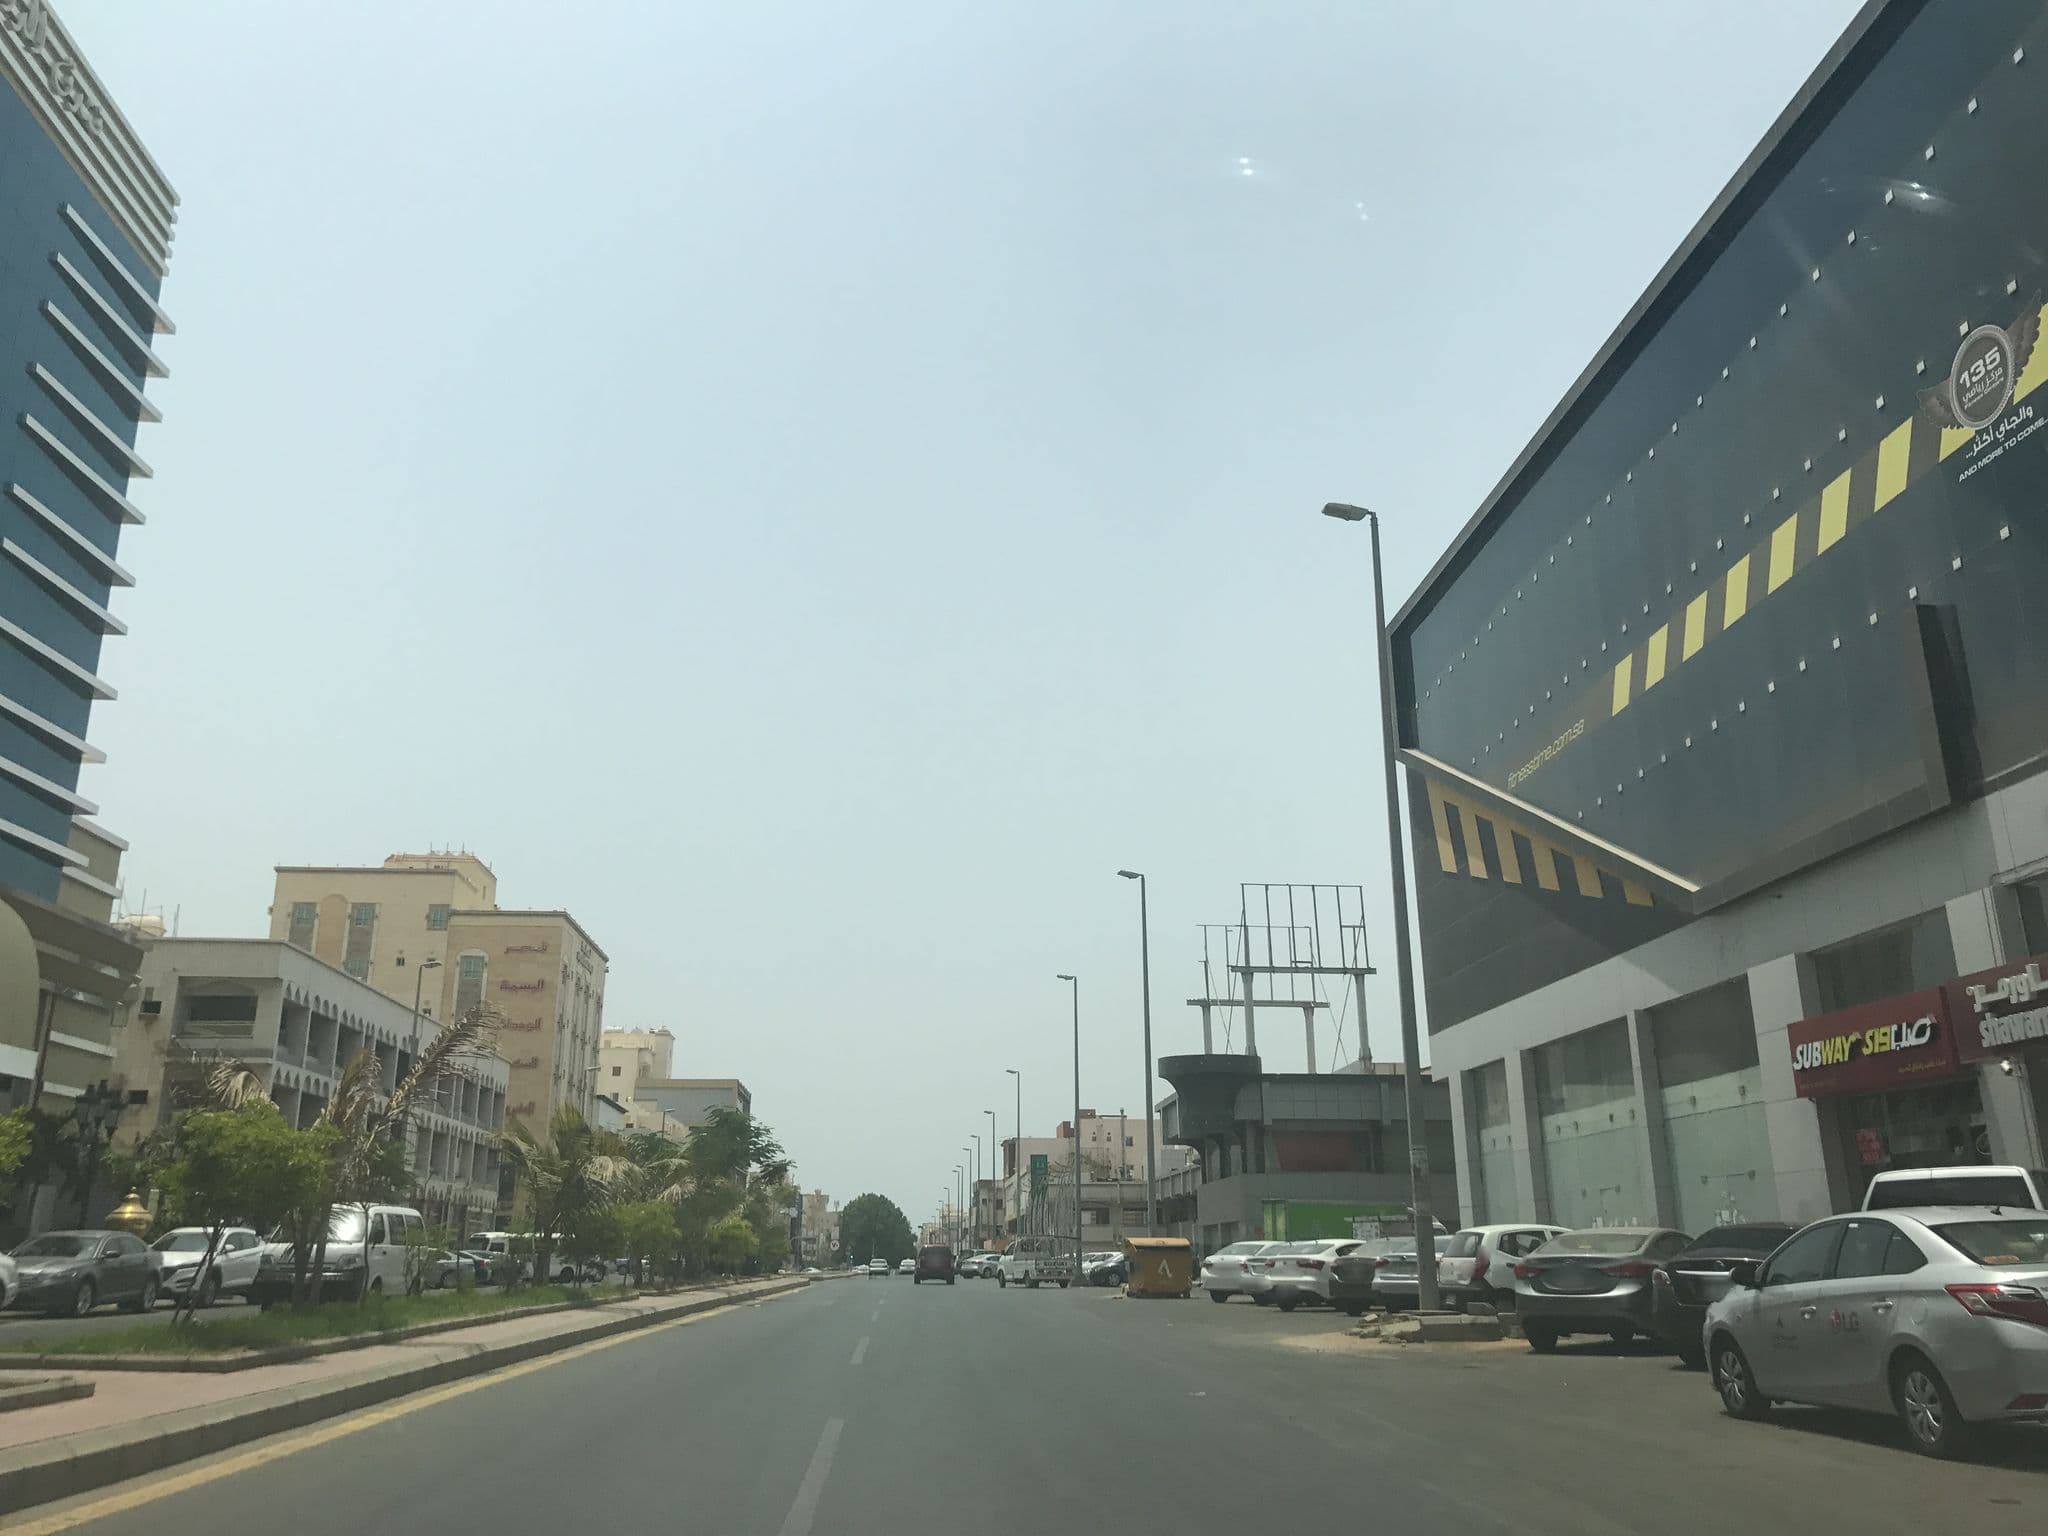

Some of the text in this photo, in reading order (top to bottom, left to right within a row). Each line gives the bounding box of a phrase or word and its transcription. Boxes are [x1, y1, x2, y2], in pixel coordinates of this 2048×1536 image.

[1959, 346, 2001, 389] 135
[1958, 463, 1978, 482] AND
[1977, 444, 2004, 470] MORE
[2004, 436, 2017, 451] TO
[1793, 1032, 1861, 1070] SUBWAY
[1842, 1311, 1859, 1332] LG
